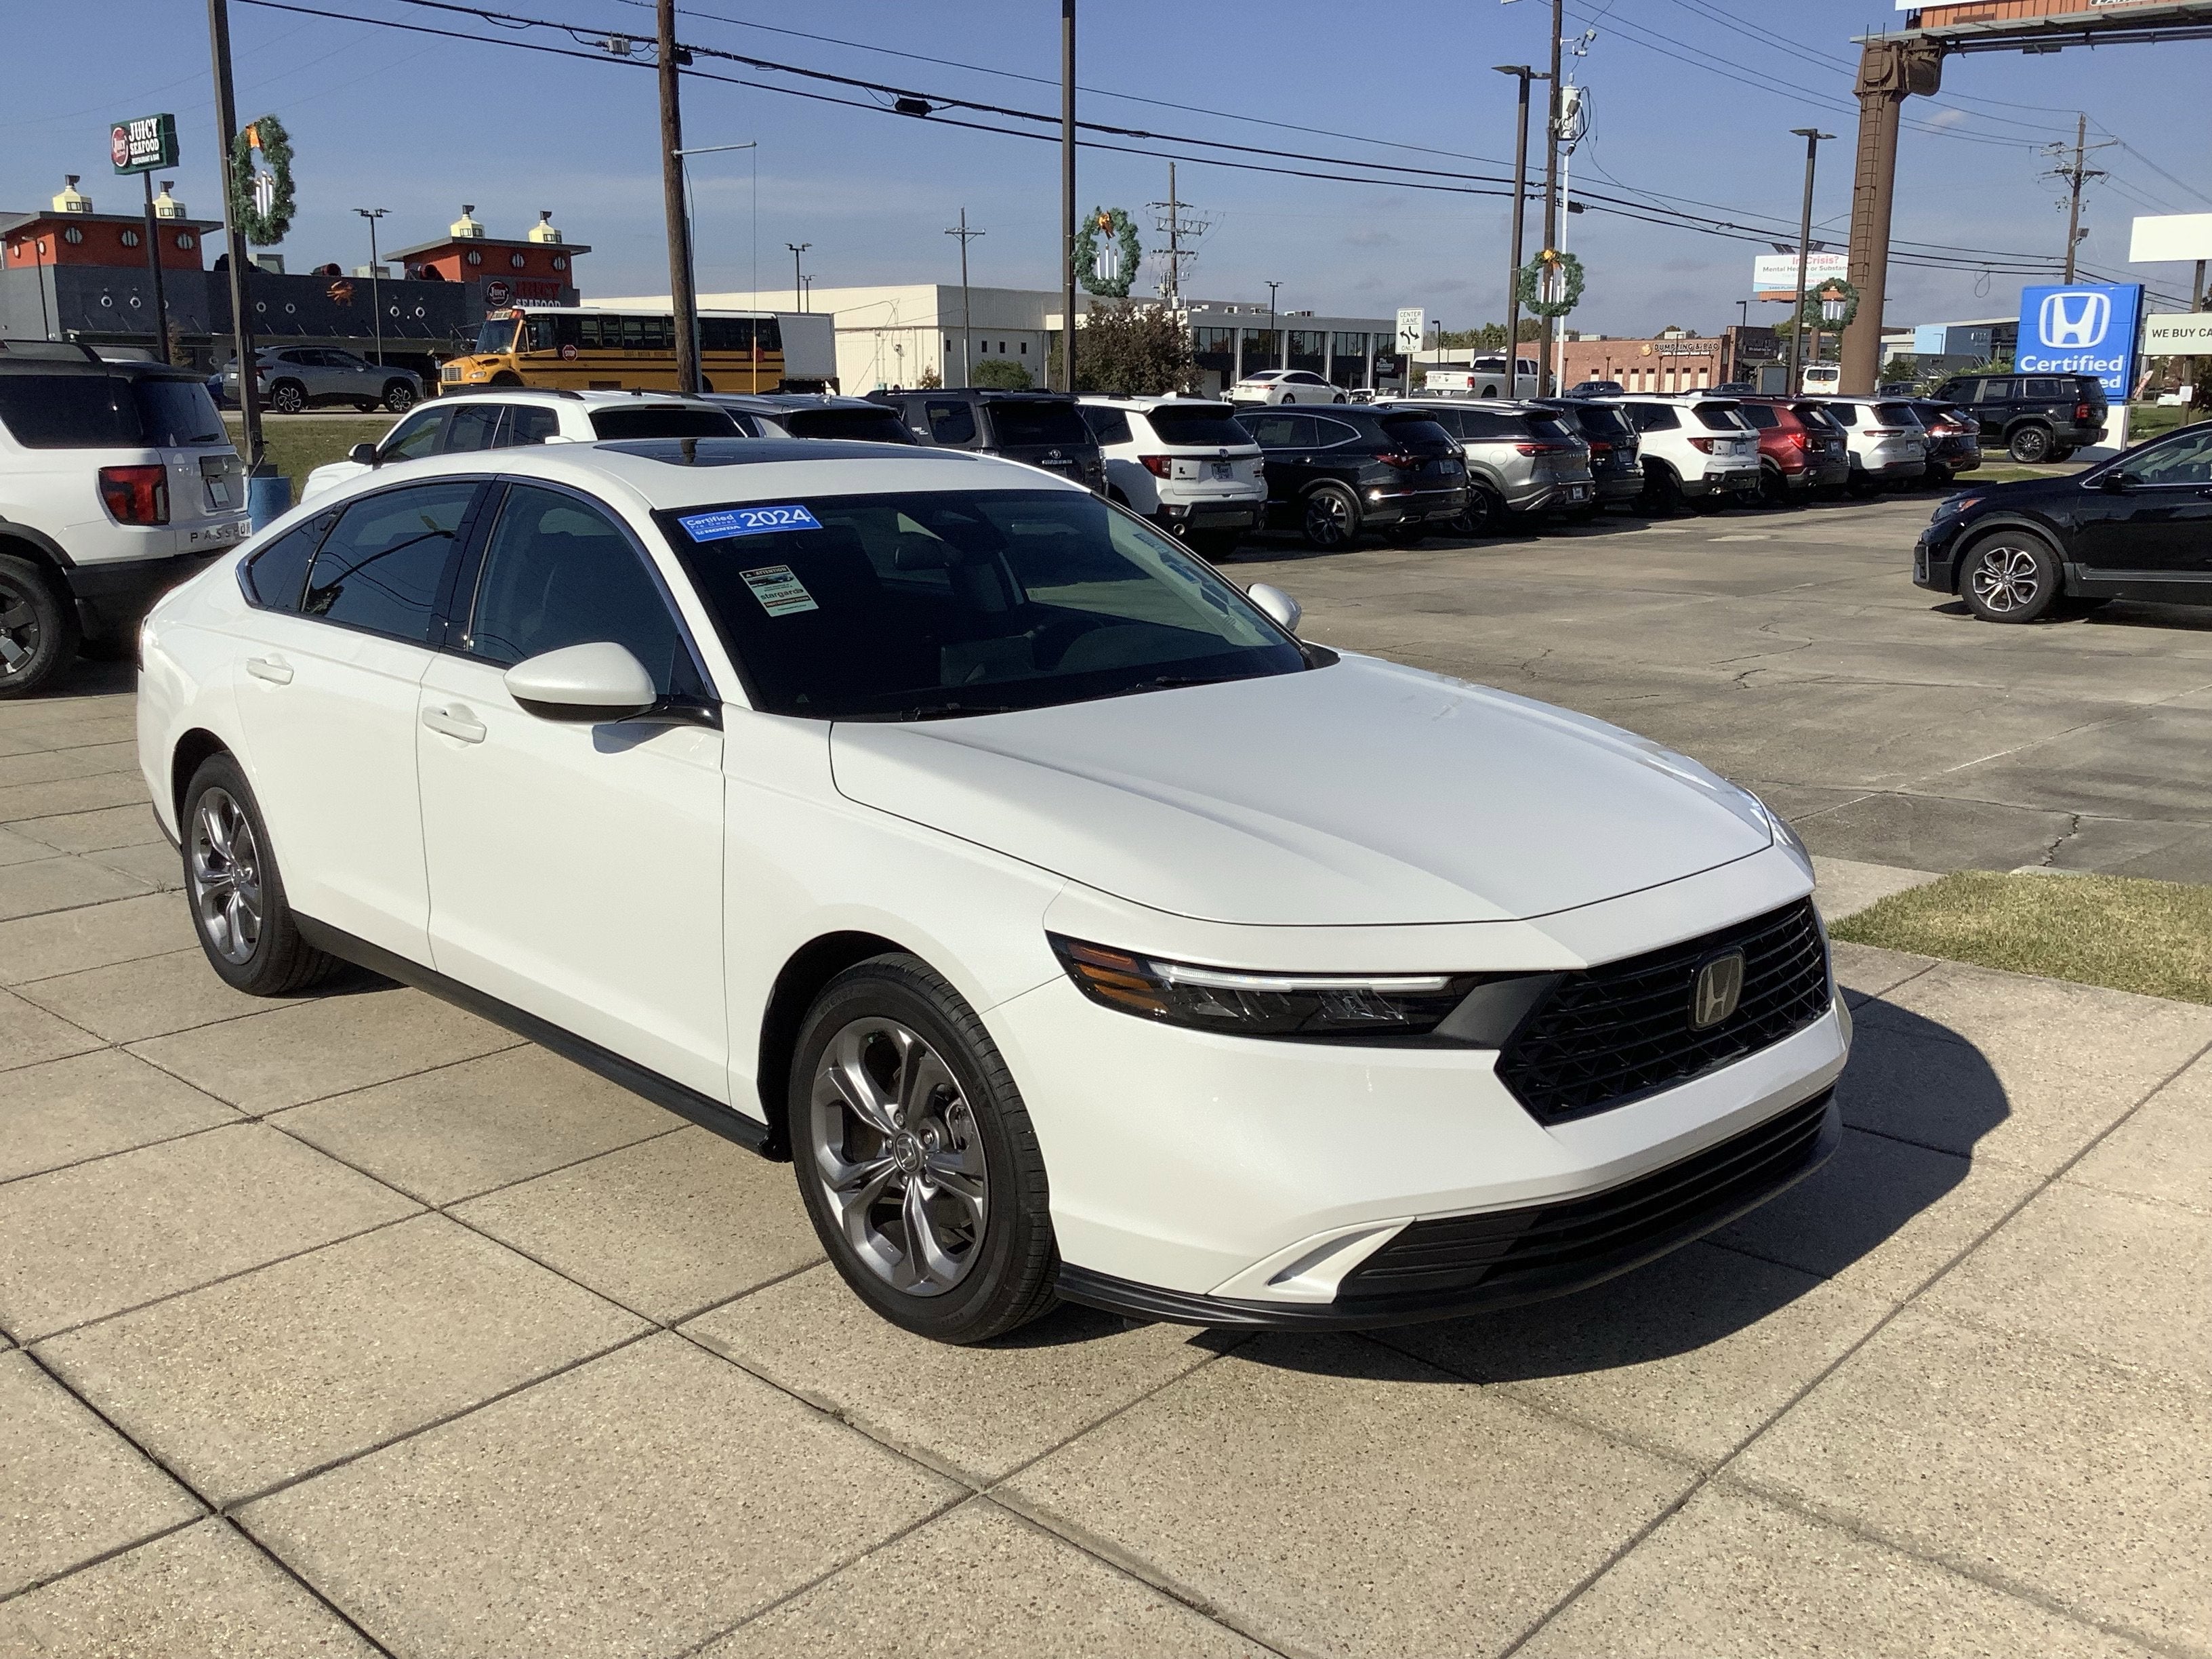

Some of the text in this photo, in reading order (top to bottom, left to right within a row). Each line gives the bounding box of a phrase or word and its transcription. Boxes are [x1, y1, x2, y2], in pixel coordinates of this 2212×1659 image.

[129, 118, 157, 142] JUICY
[129, 138, 159, 155] SEAFOOD
[1806, 255, 1839, 264] Crisis?
[2152, 329, 2169, 337] WE
[2172, 329, 2195, 337] BUY
[2020, 355, 2125, 372] Certified
[2101, 375, 2122, 388] ed
[687, 514, 735, 526] Certified
[740, 509, 811, 527] 2024
[704, 525, 741, 534] HONDA
[755, 567, 787, 575] ATTENTION
